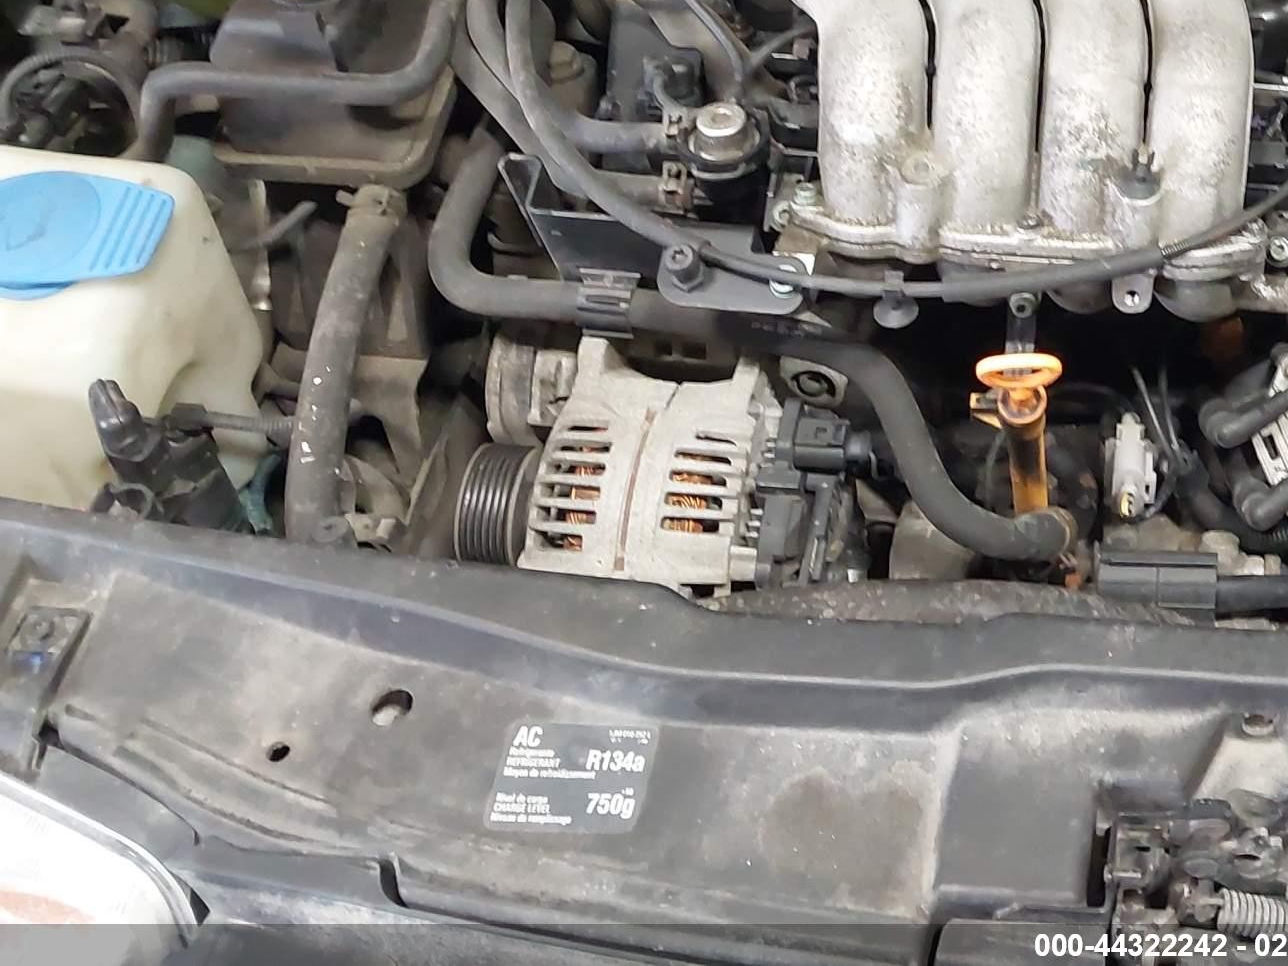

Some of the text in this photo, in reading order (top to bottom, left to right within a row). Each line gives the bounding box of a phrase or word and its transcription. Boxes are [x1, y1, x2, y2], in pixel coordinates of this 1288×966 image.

[512, 725, 544, 748] AC
[585, 749, 646, 773] R134a
[585, 792, 636, 819] 750g
